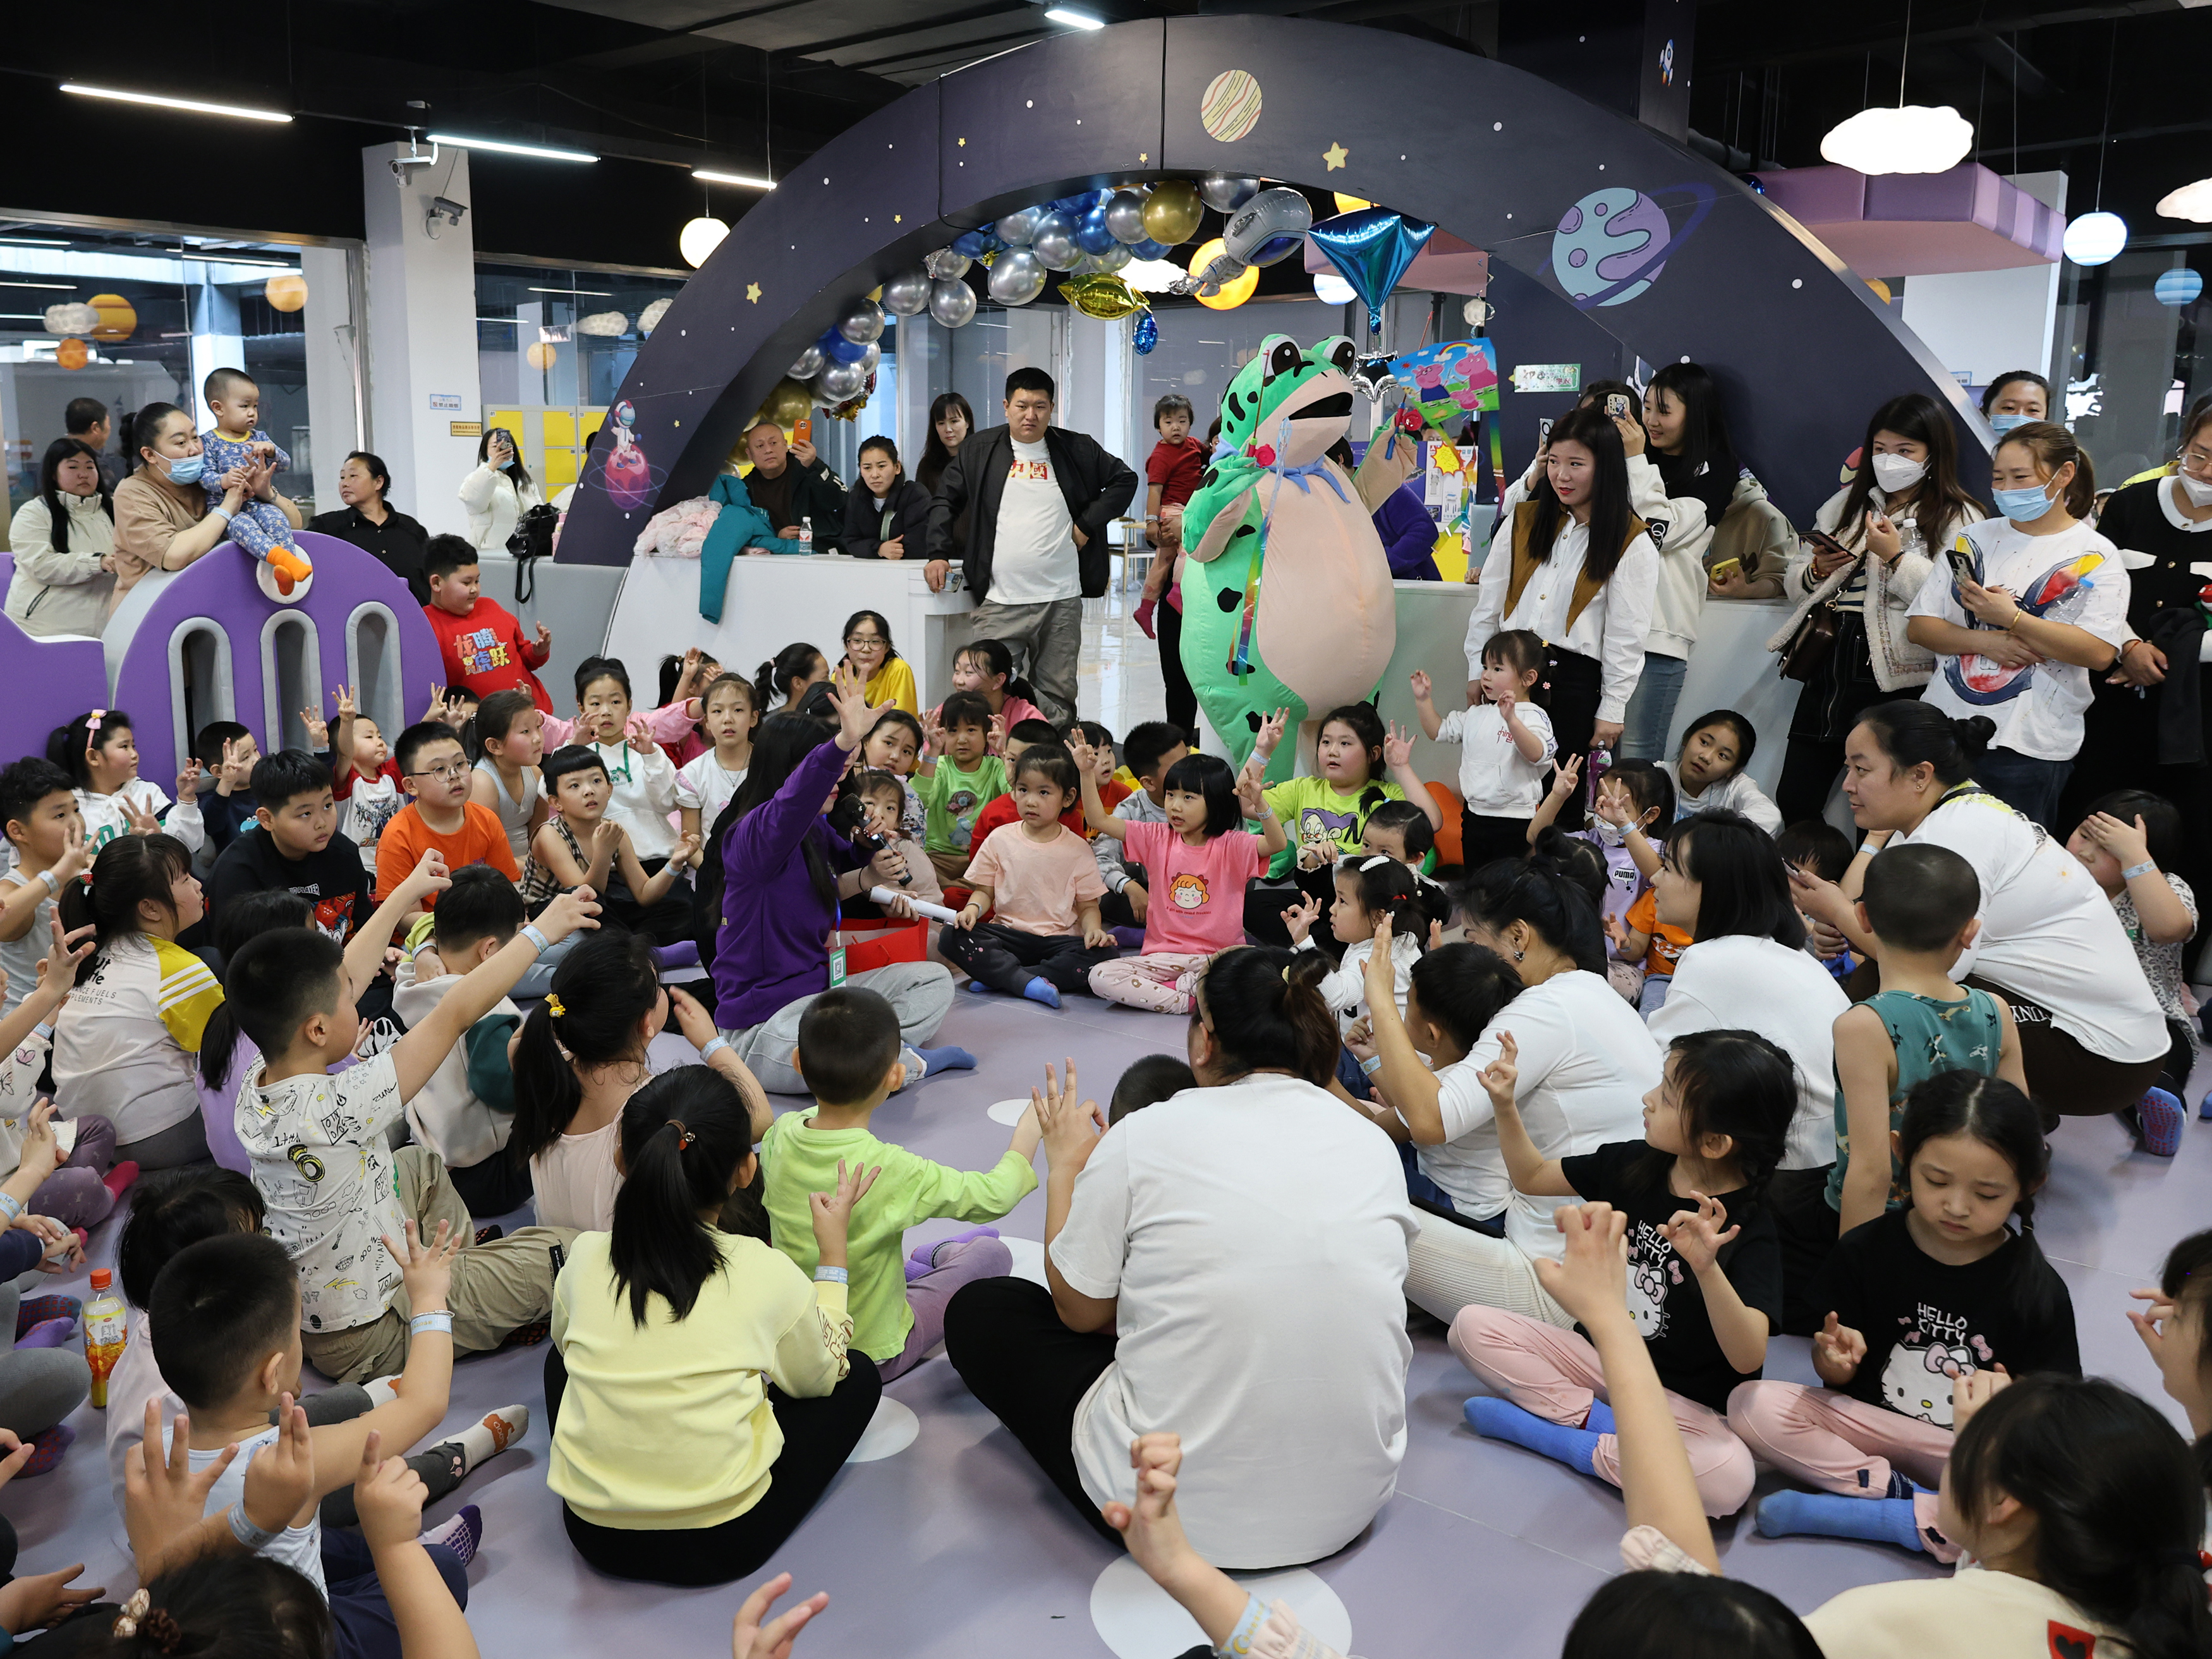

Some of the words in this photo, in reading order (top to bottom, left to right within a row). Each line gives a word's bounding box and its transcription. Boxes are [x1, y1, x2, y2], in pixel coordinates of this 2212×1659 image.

[1613, 870, 1635, 879] PUMA
[297, 884, 320, 896] PLAYER
[1636, 1233, 1667, 1268] KITTY
[1637, 1219, 1672, 1254] HELLO
[1916, 1302, 1969, 1330] HELLO
[1917, 1316, 1967, 1347] KITTY
